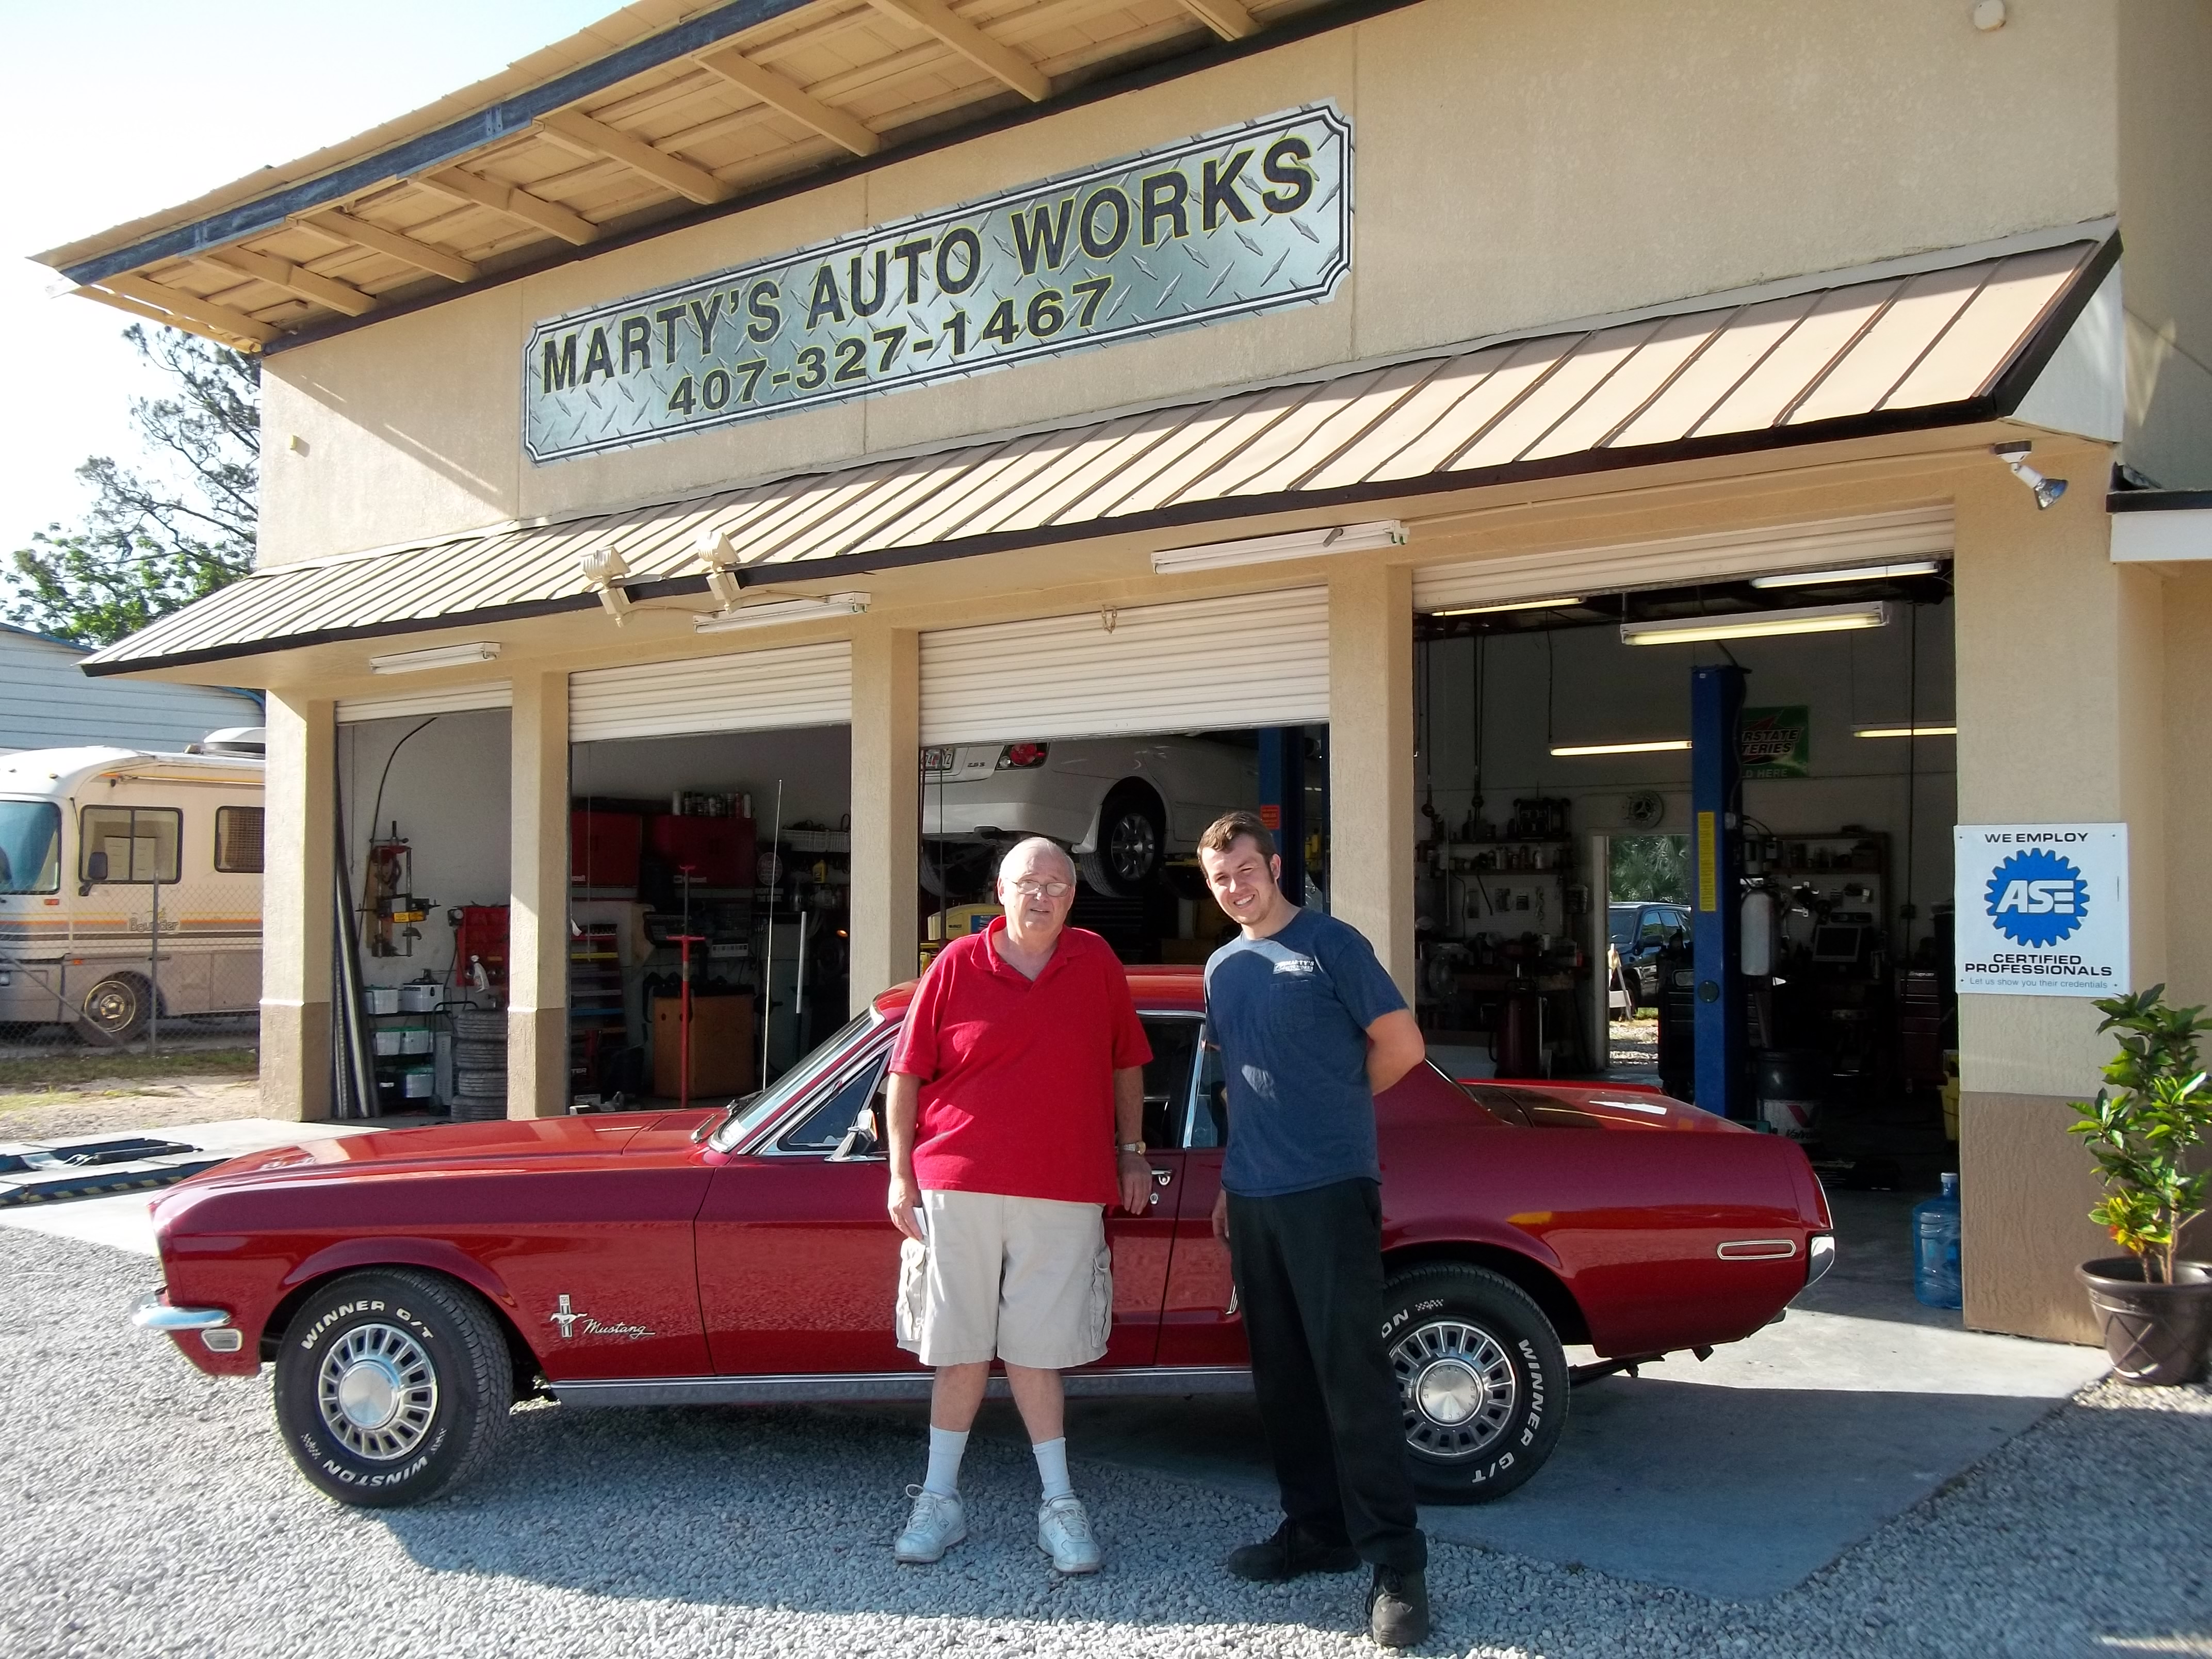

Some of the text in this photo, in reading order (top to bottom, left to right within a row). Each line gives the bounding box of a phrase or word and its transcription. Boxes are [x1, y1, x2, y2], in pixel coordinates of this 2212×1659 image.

[543, 135, 1315, 394] MARTY'S AUTO WORKS
[669, 275, 1114, 416] 407-327-1467
[1742, 729, 1798, 741] RSTATE
[1756, 769, 1788, 778] HERE
[1985, 833, 2088, 843] WE EMPLOY
[1995, 880, 2074, 913] ASE
[129, 917, 179, 932] Bouder
[1993, 954, 2081, 965] CERTIFIED
[1965, 964, 2112, 976] PROFESSIONALS
[2060, 980, 2108, 989] credentials
[301, 1300, 434, 1350] WINNER G/T
[582, 1319, 656, 1339] Mustang
[1472, 1339, 1543, 1483] WINNER G/T
[322, 1456, 428, 1487] WINSTON
